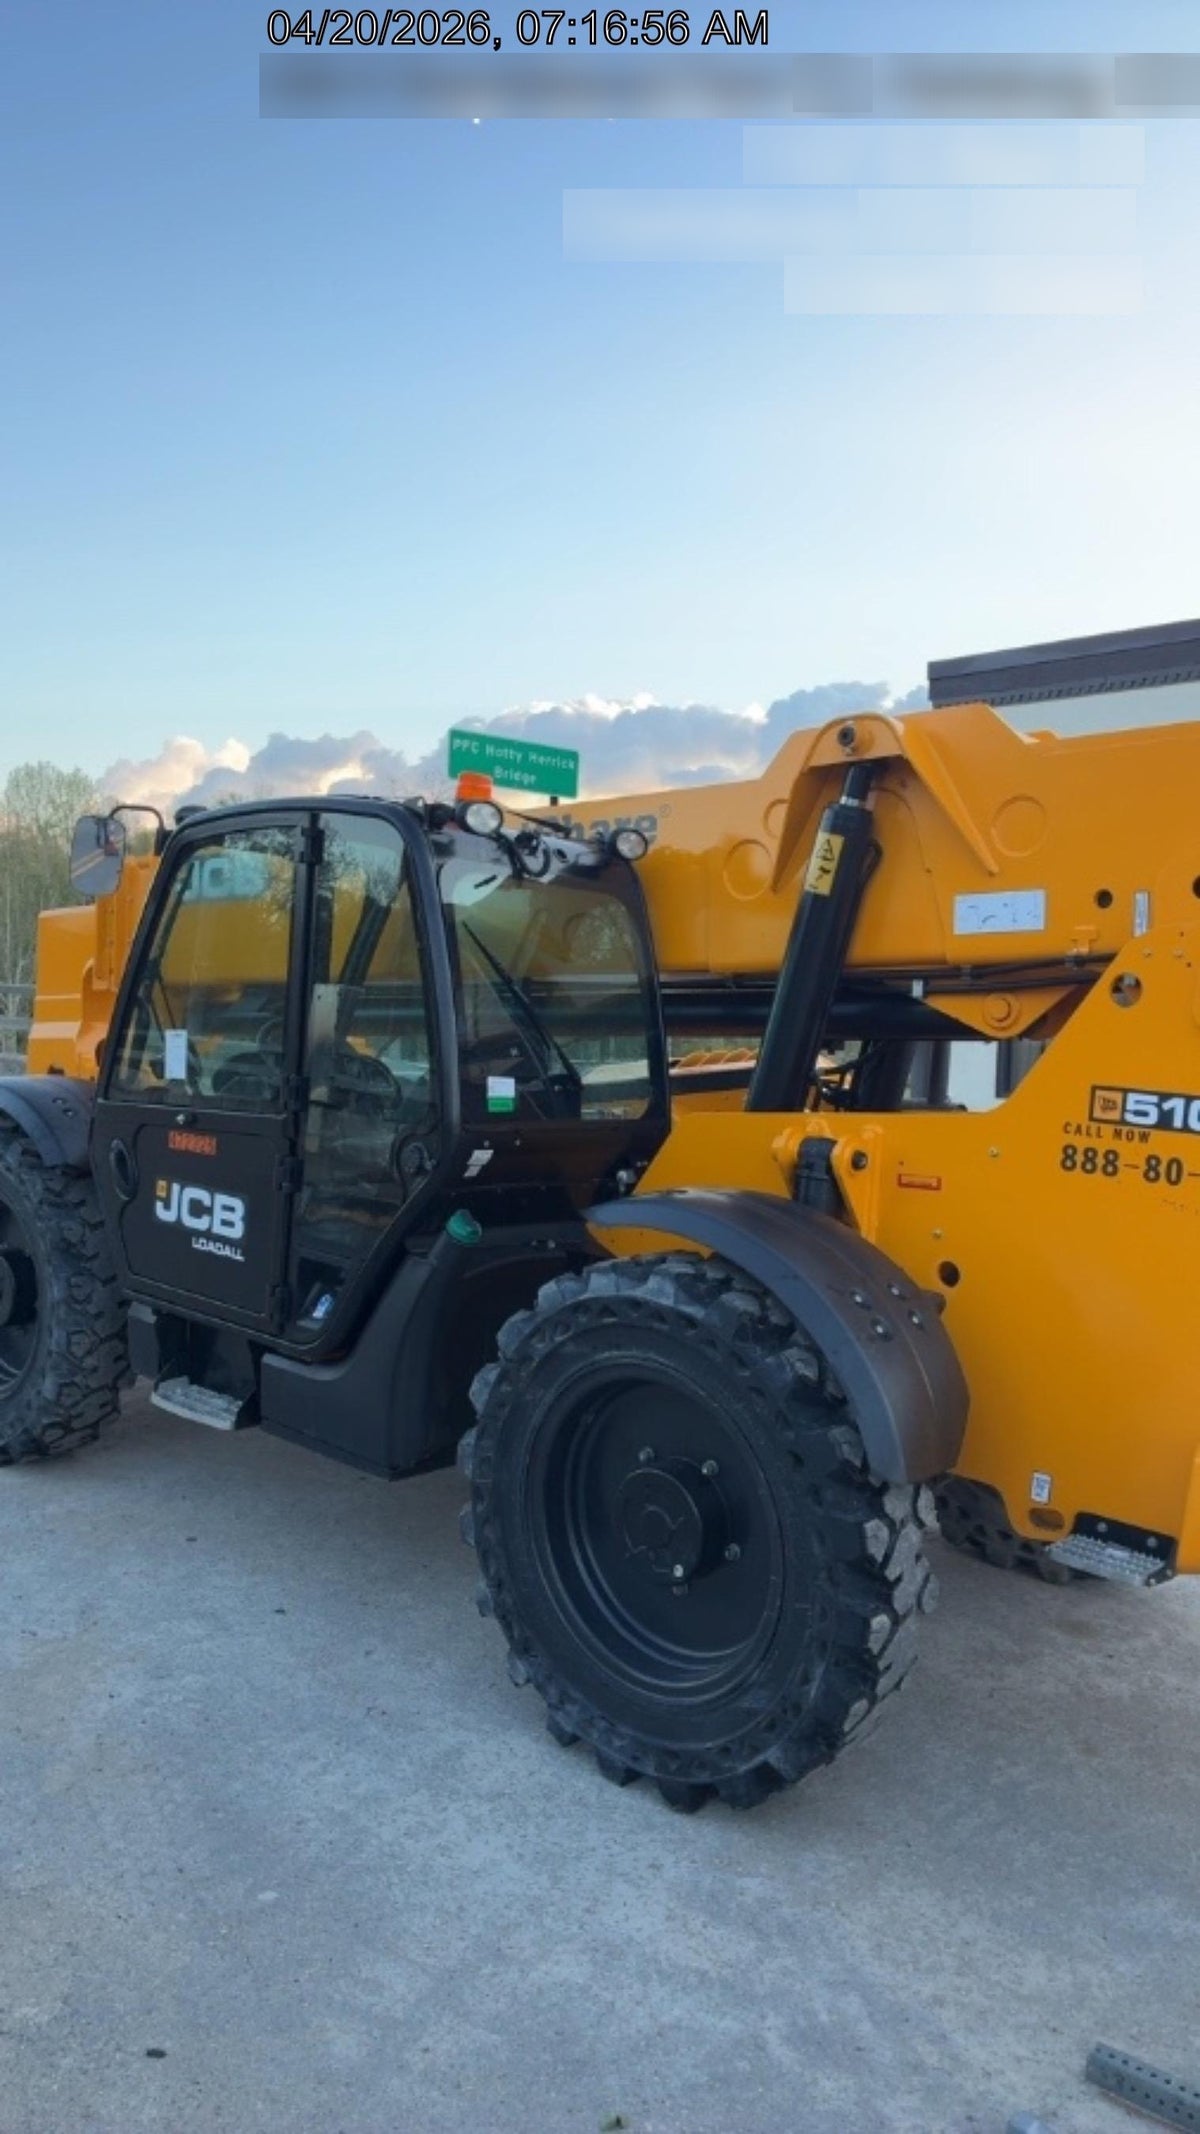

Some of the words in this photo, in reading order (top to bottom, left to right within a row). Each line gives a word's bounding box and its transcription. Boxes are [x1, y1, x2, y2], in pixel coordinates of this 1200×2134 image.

[494, 765, 537, 785] Bridge
[1063, 1122, 1104, 1139] CALL
[1113, 1128, 1151, 1144] NOW
[156, 1181, 245, 1240] JCB
[191, 1236, 245, 1262] LOADALL
